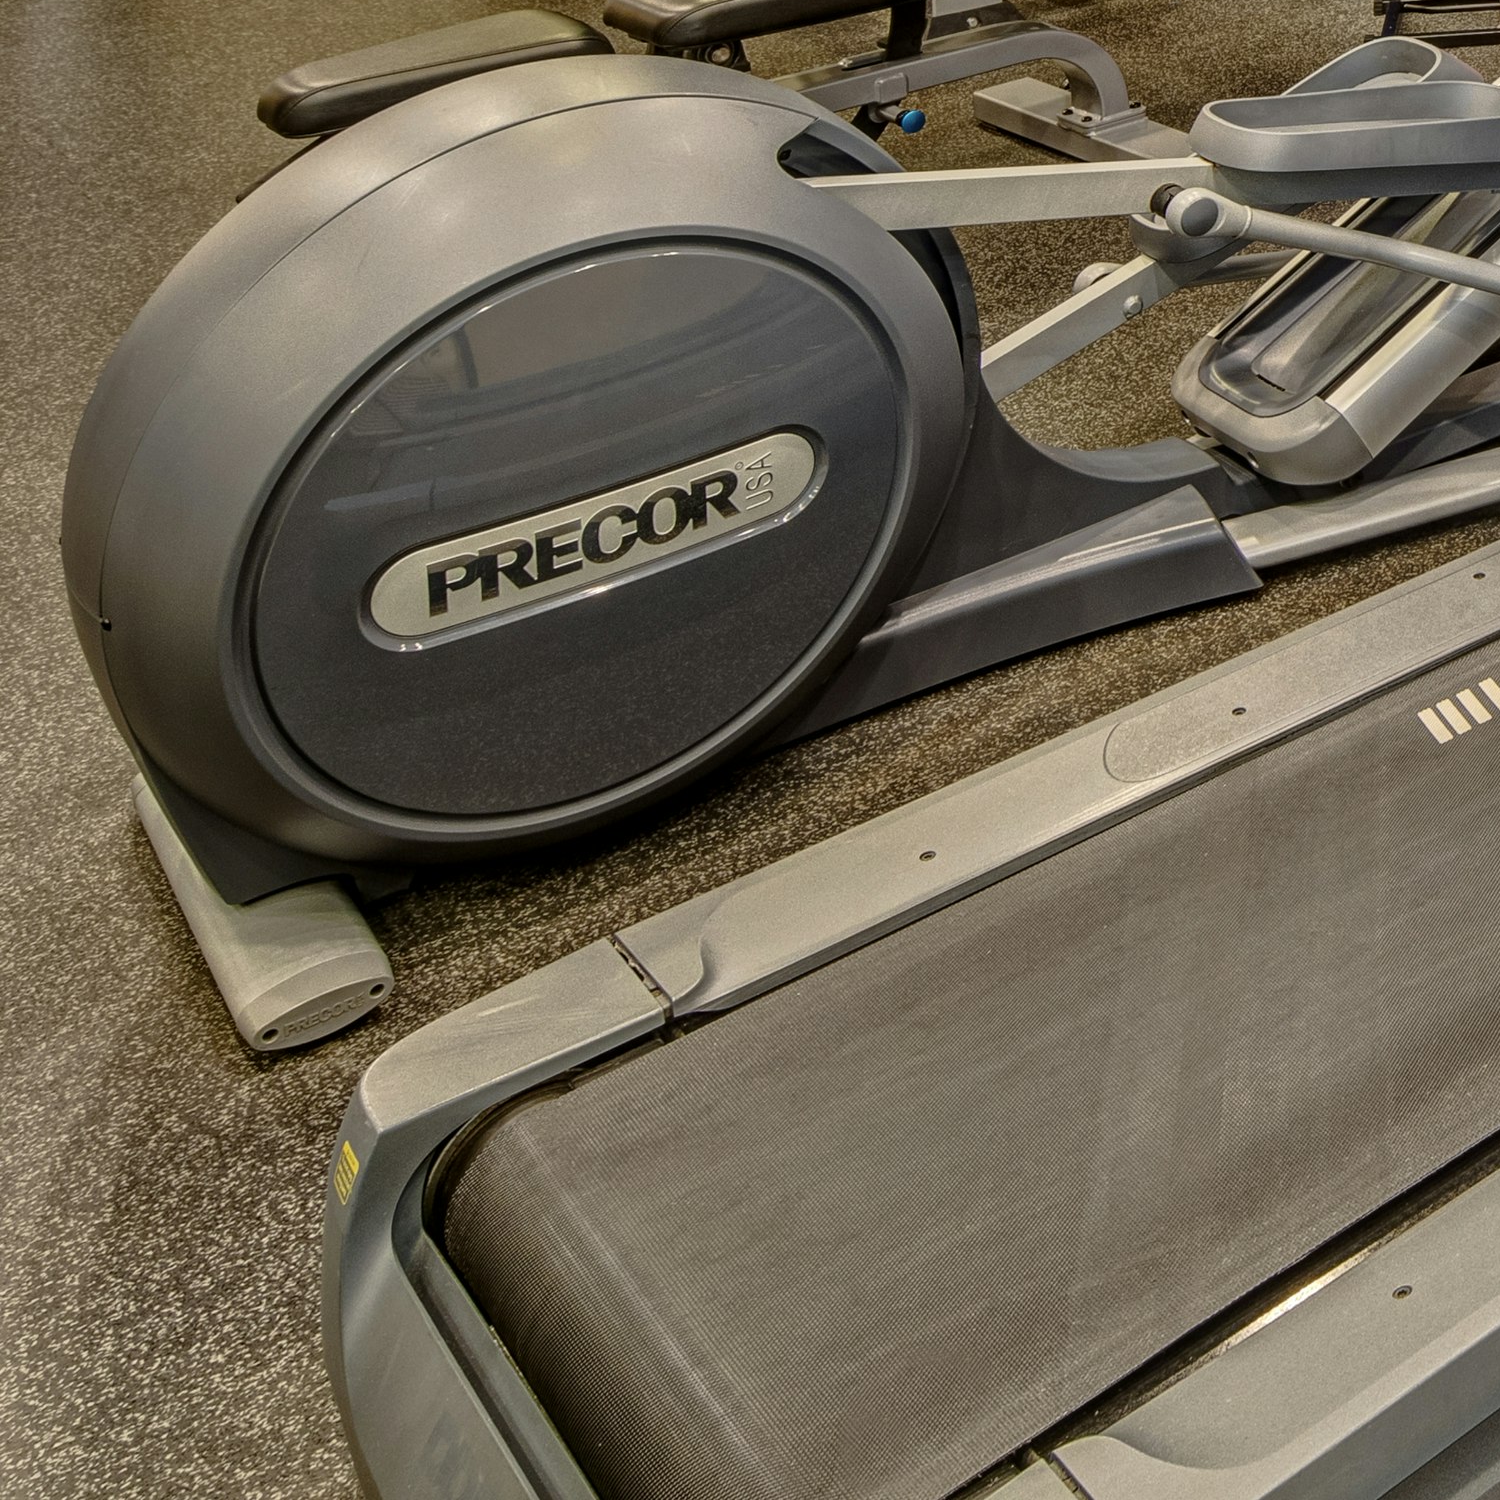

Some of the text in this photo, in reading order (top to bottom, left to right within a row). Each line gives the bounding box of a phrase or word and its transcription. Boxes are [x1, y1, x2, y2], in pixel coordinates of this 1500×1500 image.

[425, 450, 775, 619] PRECOR USA
[283, 997, 358, 1038] PRECOR
